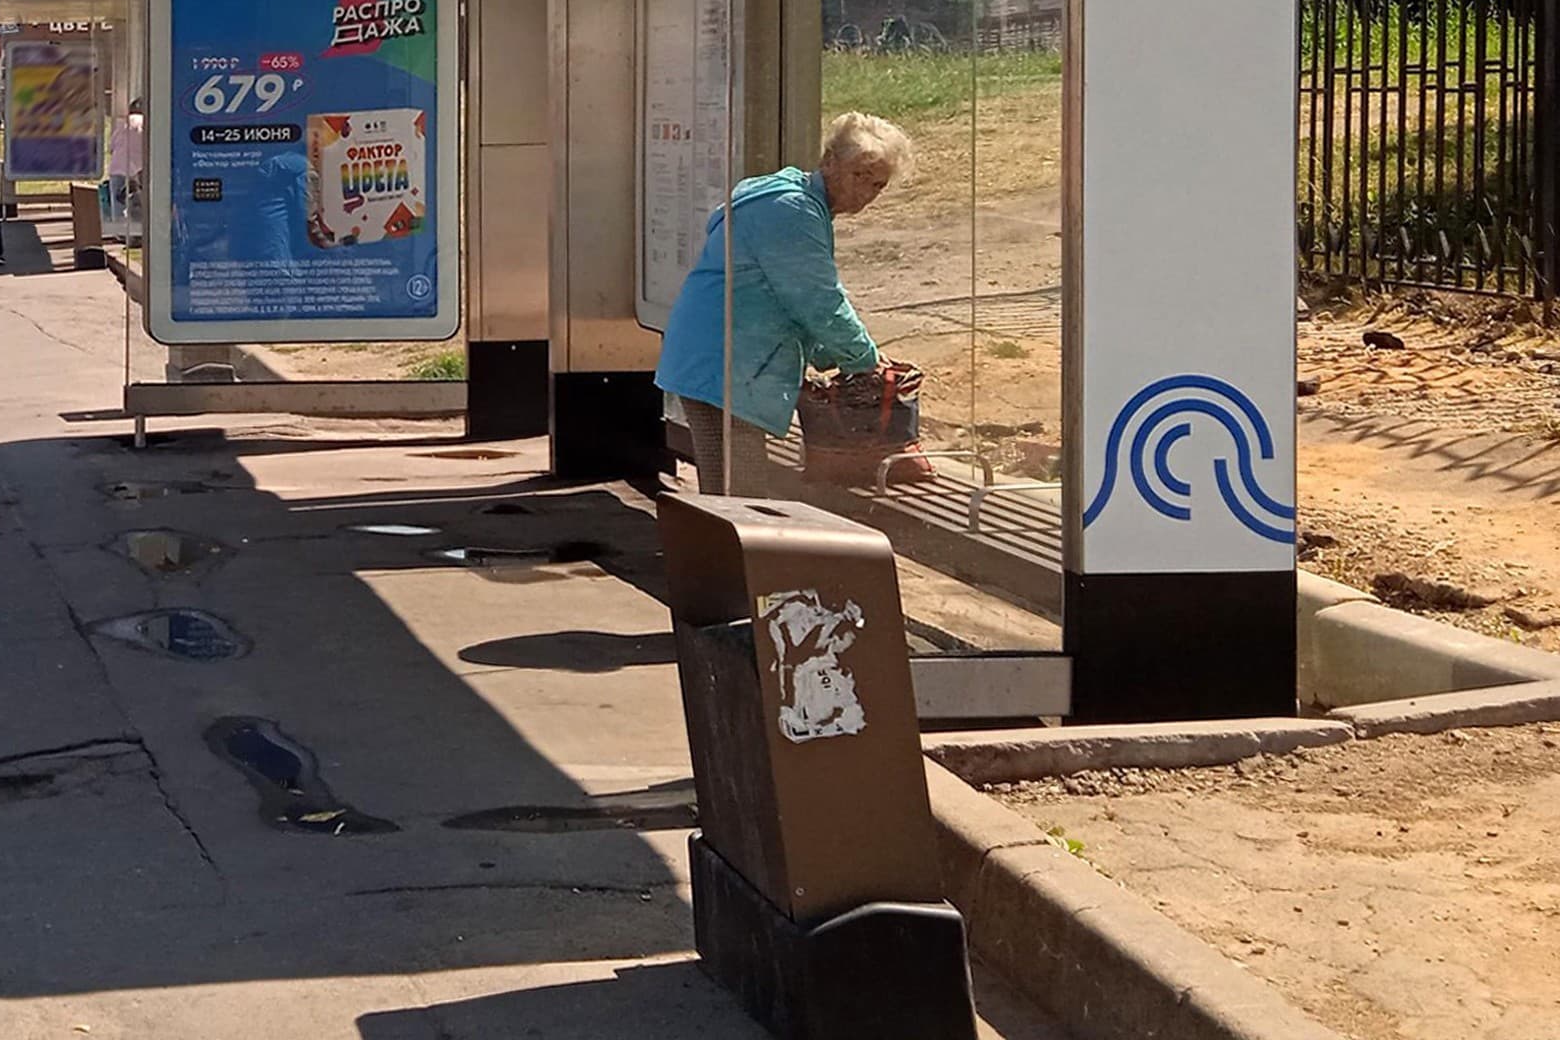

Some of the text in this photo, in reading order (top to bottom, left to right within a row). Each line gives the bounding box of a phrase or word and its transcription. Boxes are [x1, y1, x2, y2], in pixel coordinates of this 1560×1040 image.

[331, 16, 420, 46] ДАЖА
[194, 73, 286, 114] 679
[243, 127, 291, 141] ИЮНЯ
[346, 144, 403, 160] ФАКТОР
[340, 159, 410, 202] ЦВЕТА
